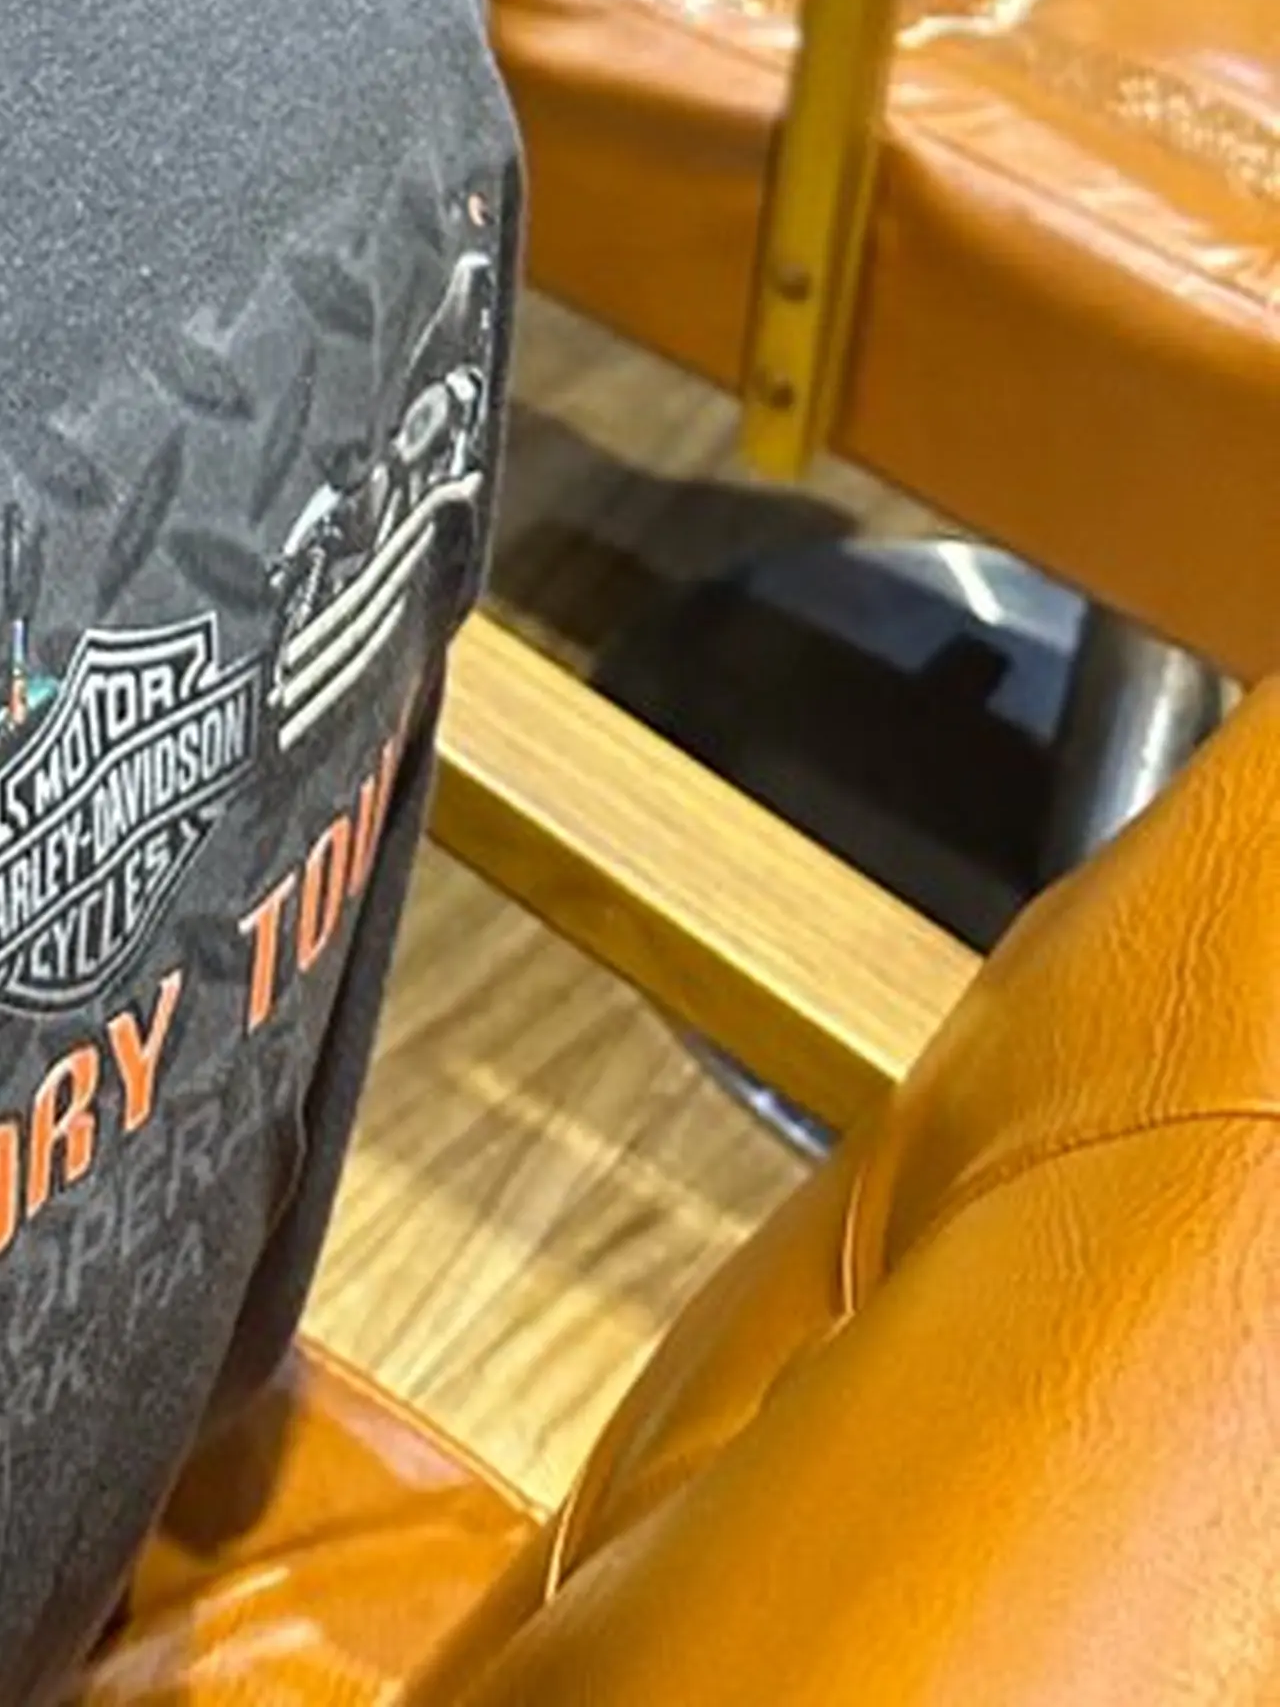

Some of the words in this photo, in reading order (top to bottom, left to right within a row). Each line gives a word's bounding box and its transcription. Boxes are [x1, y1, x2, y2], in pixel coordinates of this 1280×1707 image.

[33, 663, 174, 818] MOTOR
[30, 831, 172, 980] CYCLES
[238, 707, 414, 1034] TOU
